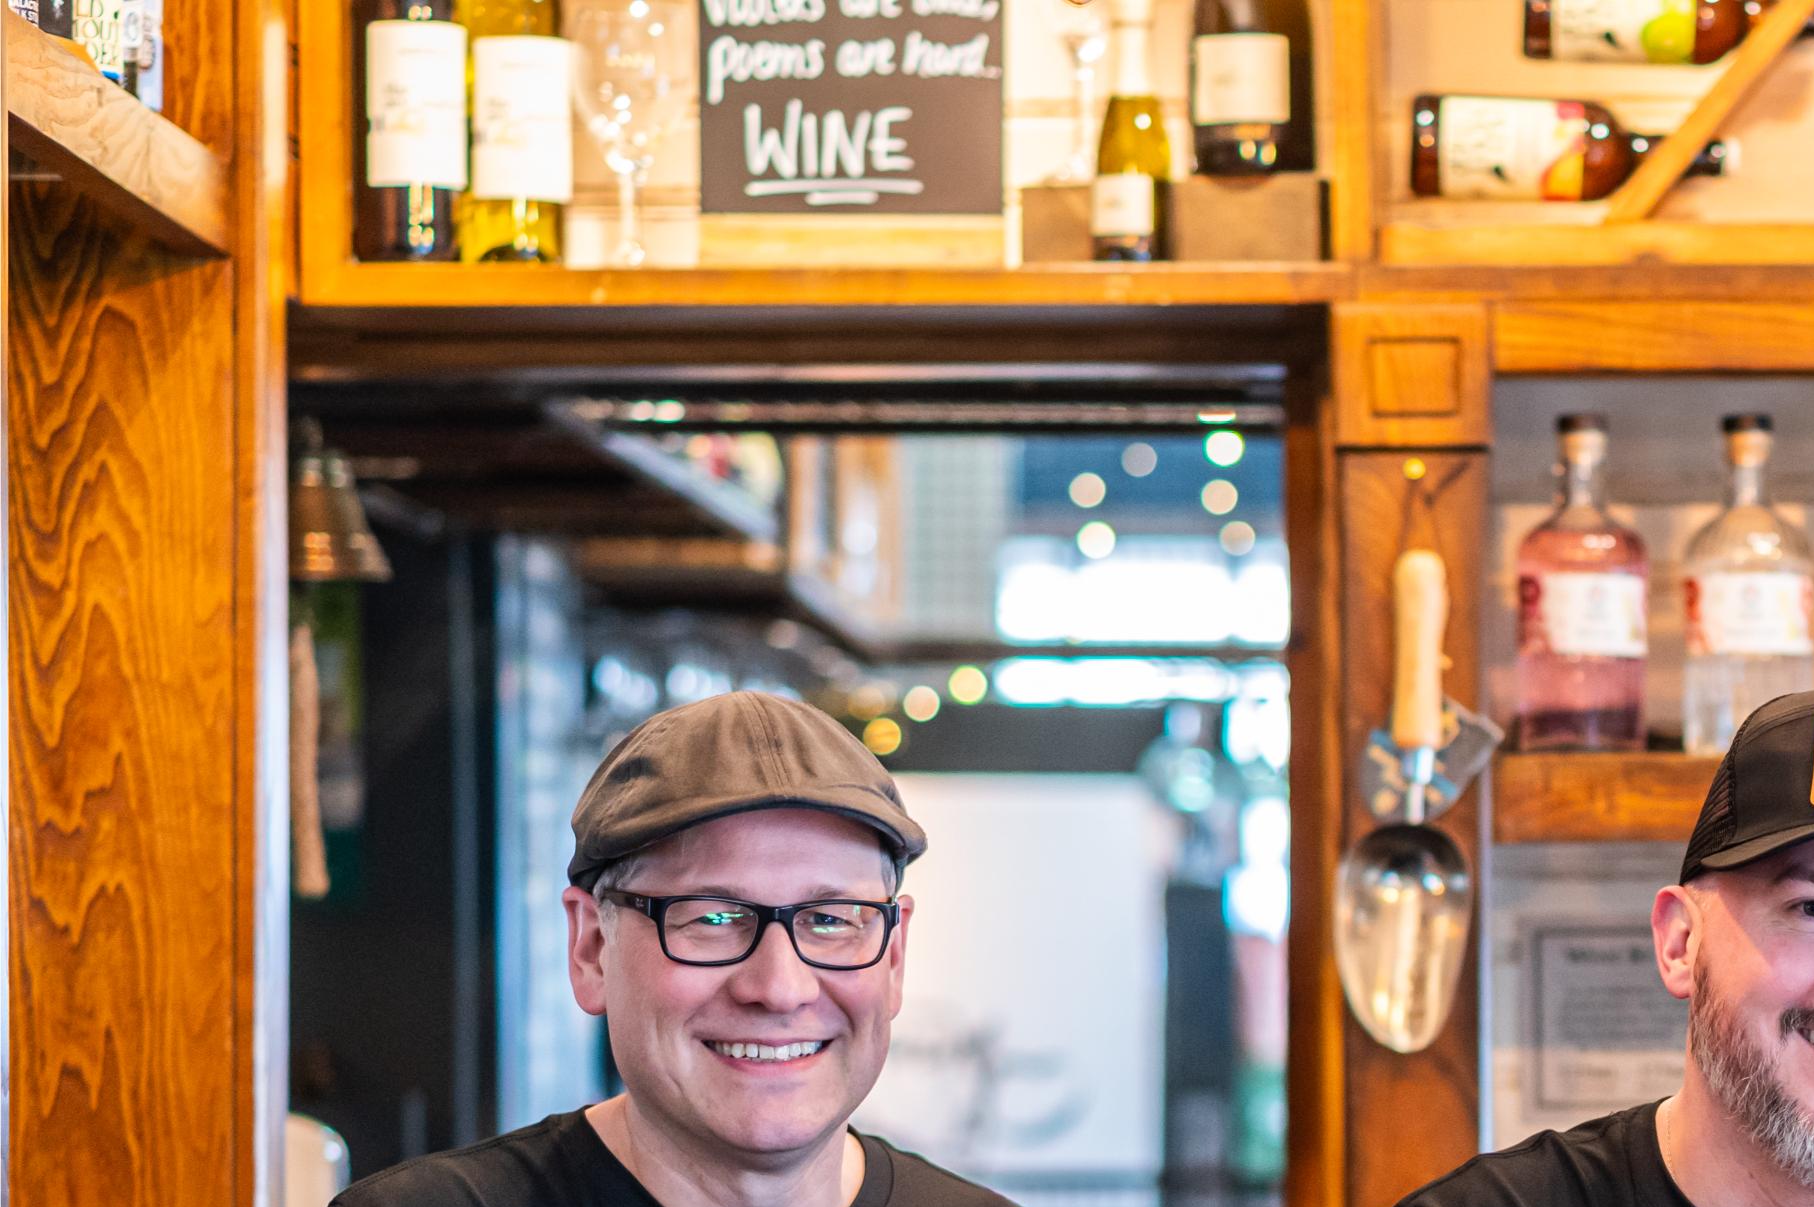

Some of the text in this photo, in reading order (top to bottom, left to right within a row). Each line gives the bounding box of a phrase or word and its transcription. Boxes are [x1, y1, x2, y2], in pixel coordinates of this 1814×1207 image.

[706, 35, 826, 105] poems
[836, 37, 897, 77] are
[744, 99, 916, 178] WINE
